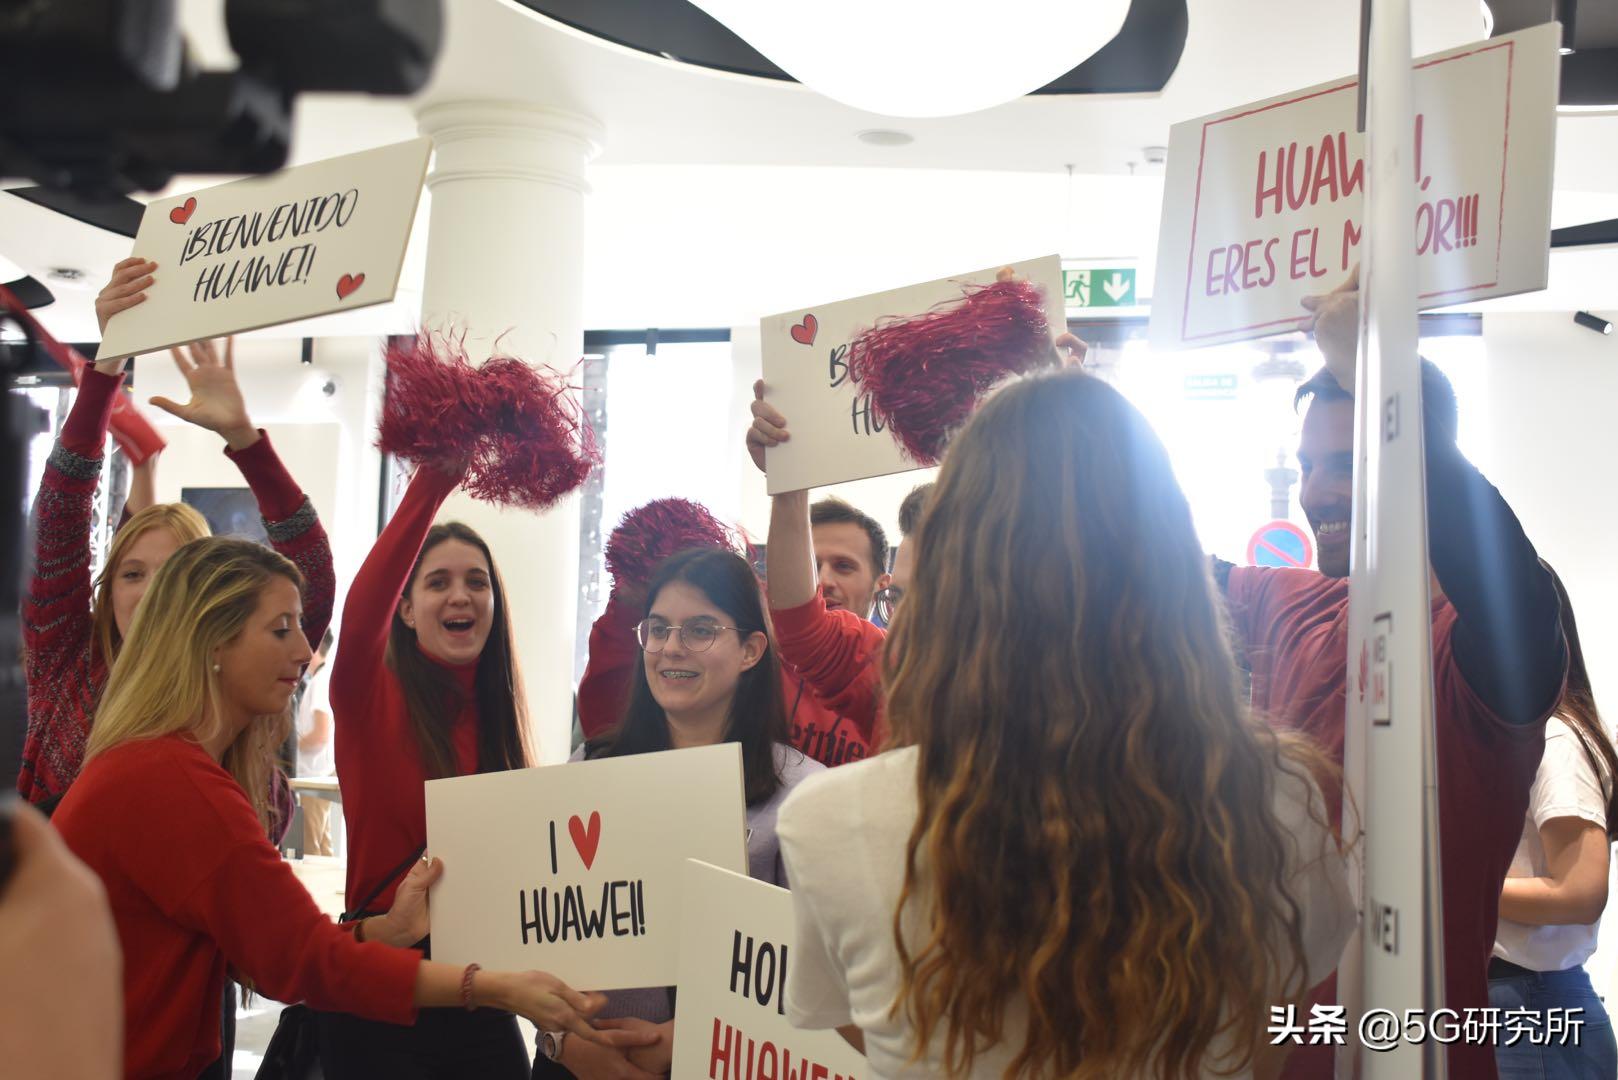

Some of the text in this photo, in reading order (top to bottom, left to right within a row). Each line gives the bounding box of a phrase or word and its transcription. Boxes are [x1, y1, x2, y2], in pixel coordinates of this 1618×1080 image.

[1255, 113, 1431, 219] HUAWI,
[194, 243, 317, 302] HUAWEI!
[1206, 193, 1479, 296] ERES EL MOR!!!
[549, 820, 557, 874] I
[520, 879, 646, 944] HUAWEI!
